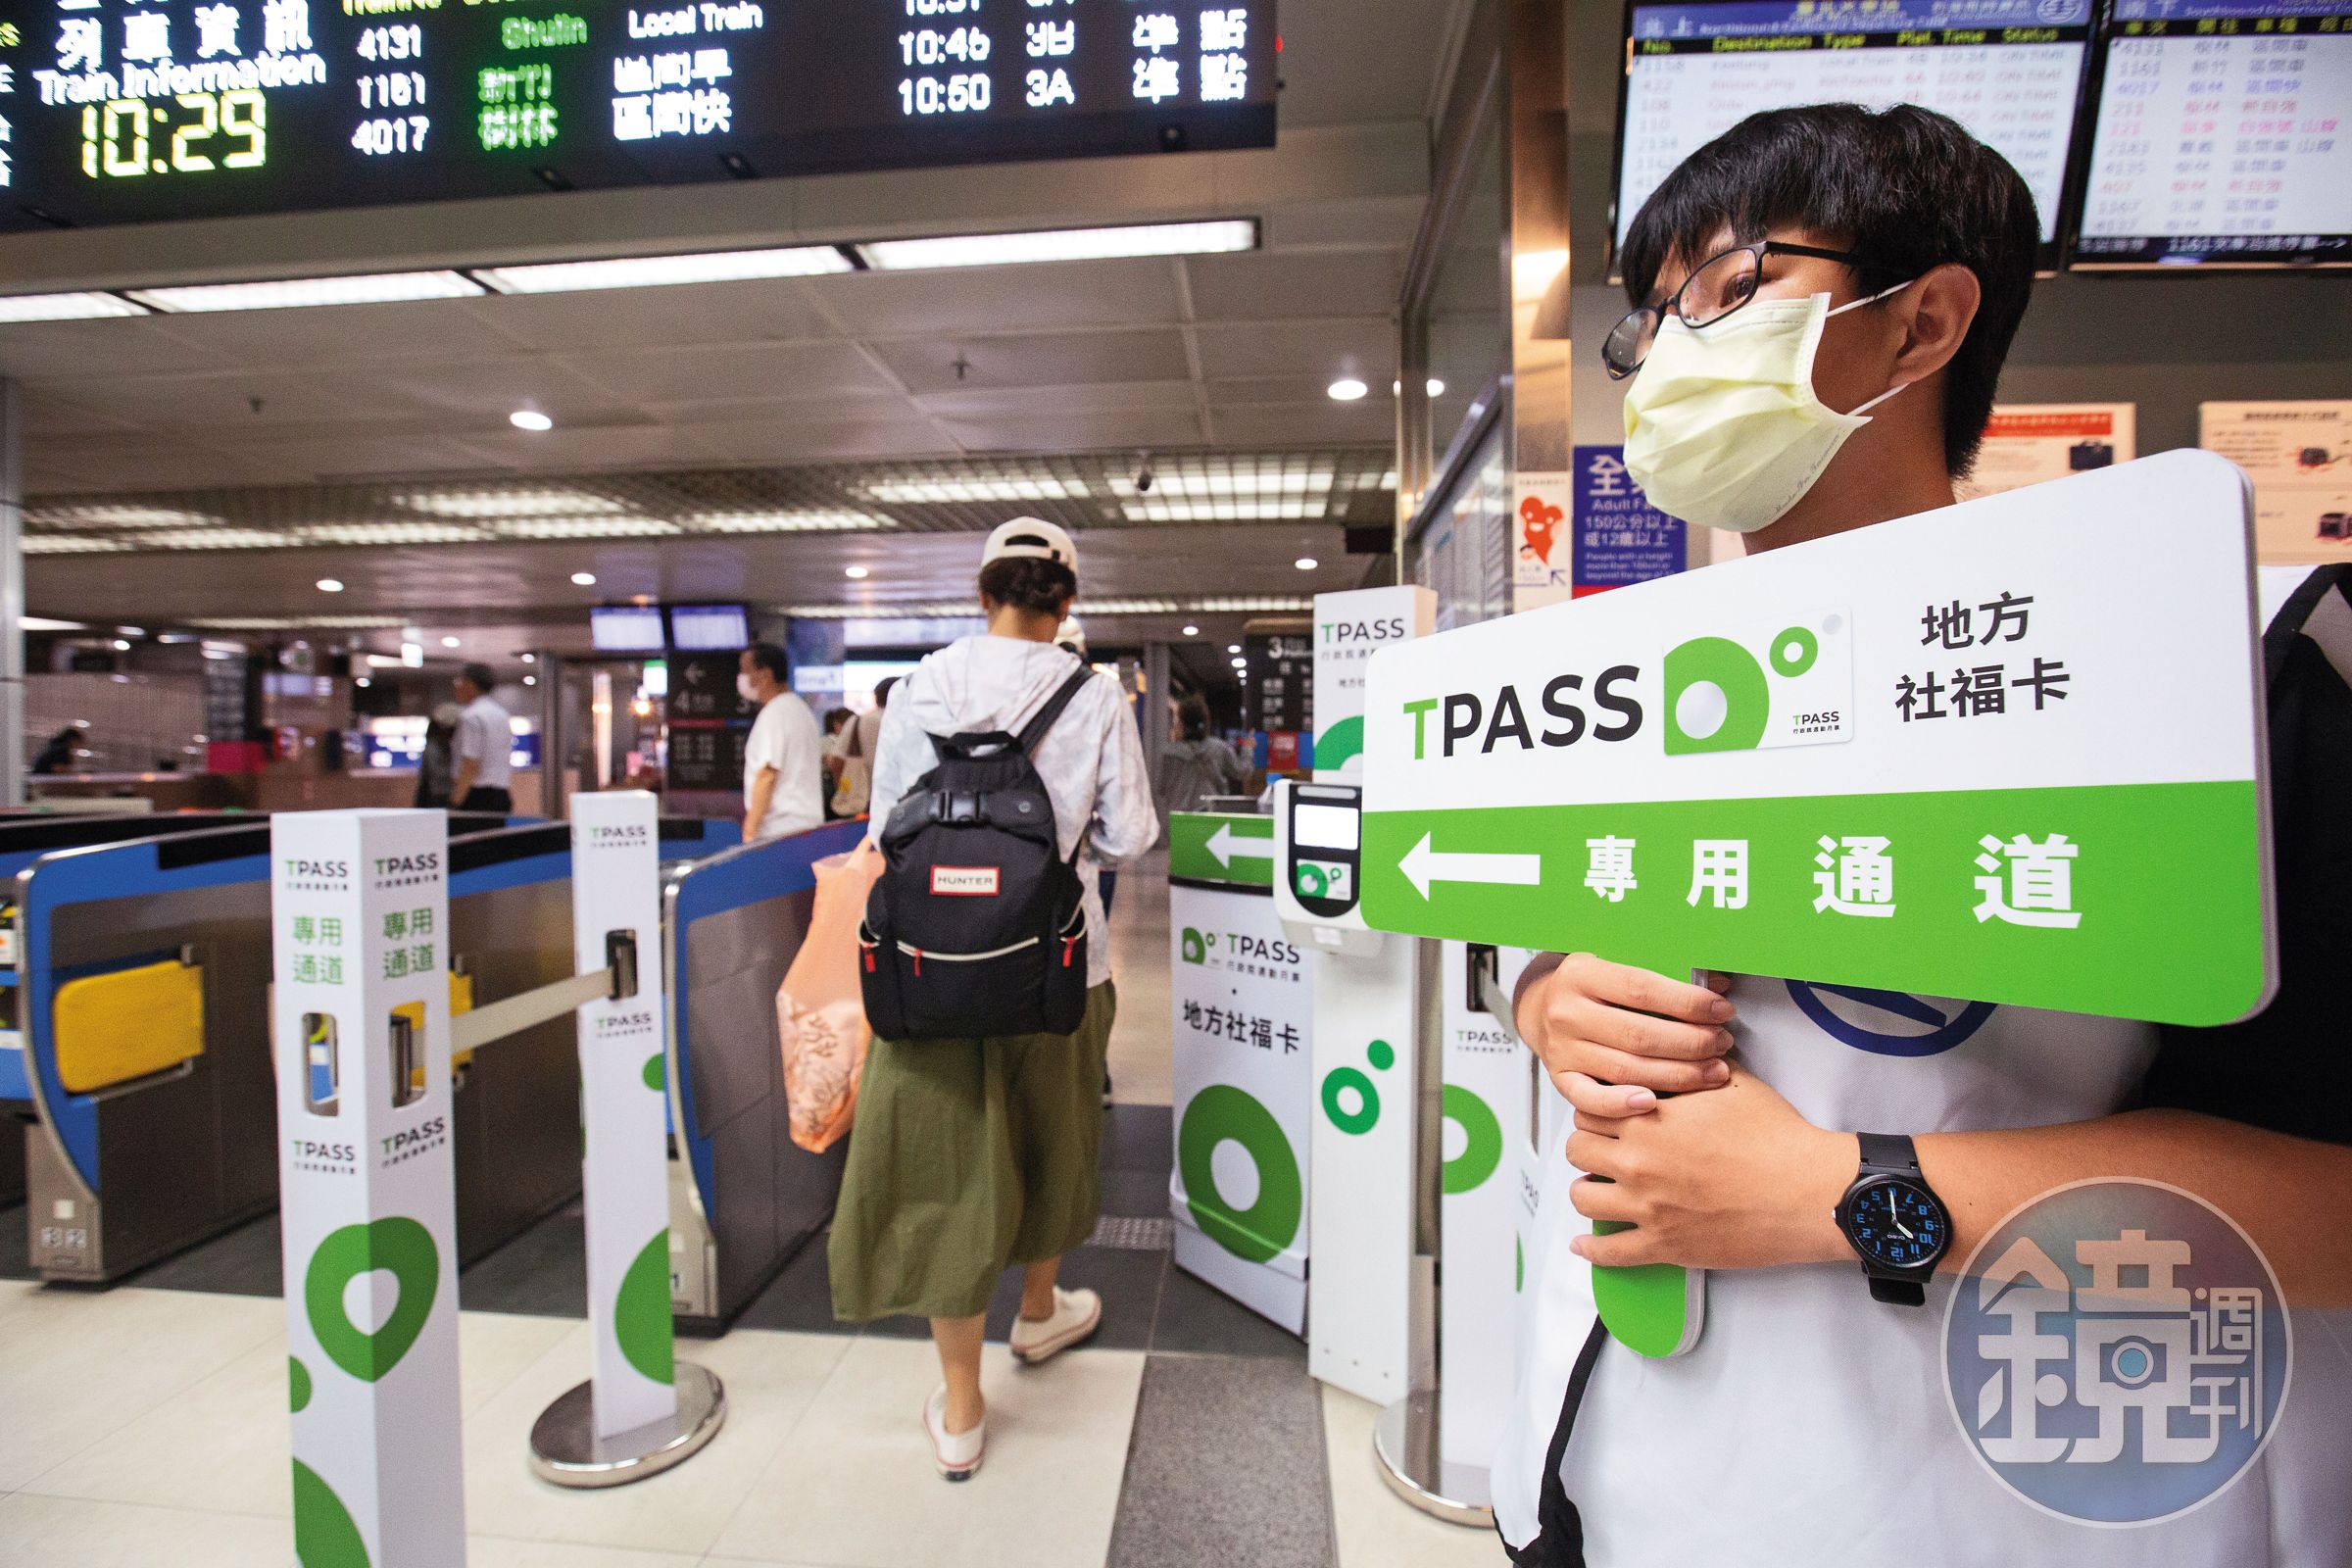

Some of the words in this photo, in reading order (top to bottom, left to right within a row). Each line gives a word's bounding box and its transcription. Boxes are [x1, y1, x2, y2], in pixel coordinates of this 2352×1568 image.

[502, 14, 588, 49] Shulin
[629, 5, 697, 38] Local
[702, 0, 763, 31] Train
[357, 24, 421, 61] 4131
[32, 69, 119, 106] Train
[122, 53, 326, 97] Information
[899, 73, 990, 116] 10:50
[1025, 68, 1075, 107] 3A
[82, 88, 266, 178] 10:29
[352, 116, 429, 155] 4017
[1592, 499, 1631, 511] Adult
[1321, 618, 1404, 643] TPASS
[1921, 592, 2036, 649] 地方
[1894, 657, 2071, 724] 社福卡
[1402, 664, 1643, 760] TPASS
[1792, 711, 1839, 725] TPASS
[590, 825, 646, 838] TPASS
[285, 859, 348, 877] TPASS
[374, 853, 439, 875] TPASS
[938, 875, 993, 886] HUNTER
[1584, 833, 2082, 929] 專用通道
[293, 916, 343, 946] 專用
[383, 907, 433, 941] 專用
[383, 944, 433, 980] 通道
[1227, 933, 1300, 964] TPASS
[293, 954, 343, 985] 通道
[596, 1011, 652, 1028] TPASS
[1183, 1000, 1299, 1054] 地方社福卡
[1457, 1030, 1512, 1045] TPASS
[293, 1140, 356, 1161] TPASS
[382, 1116, 445, 1155] TPASS
